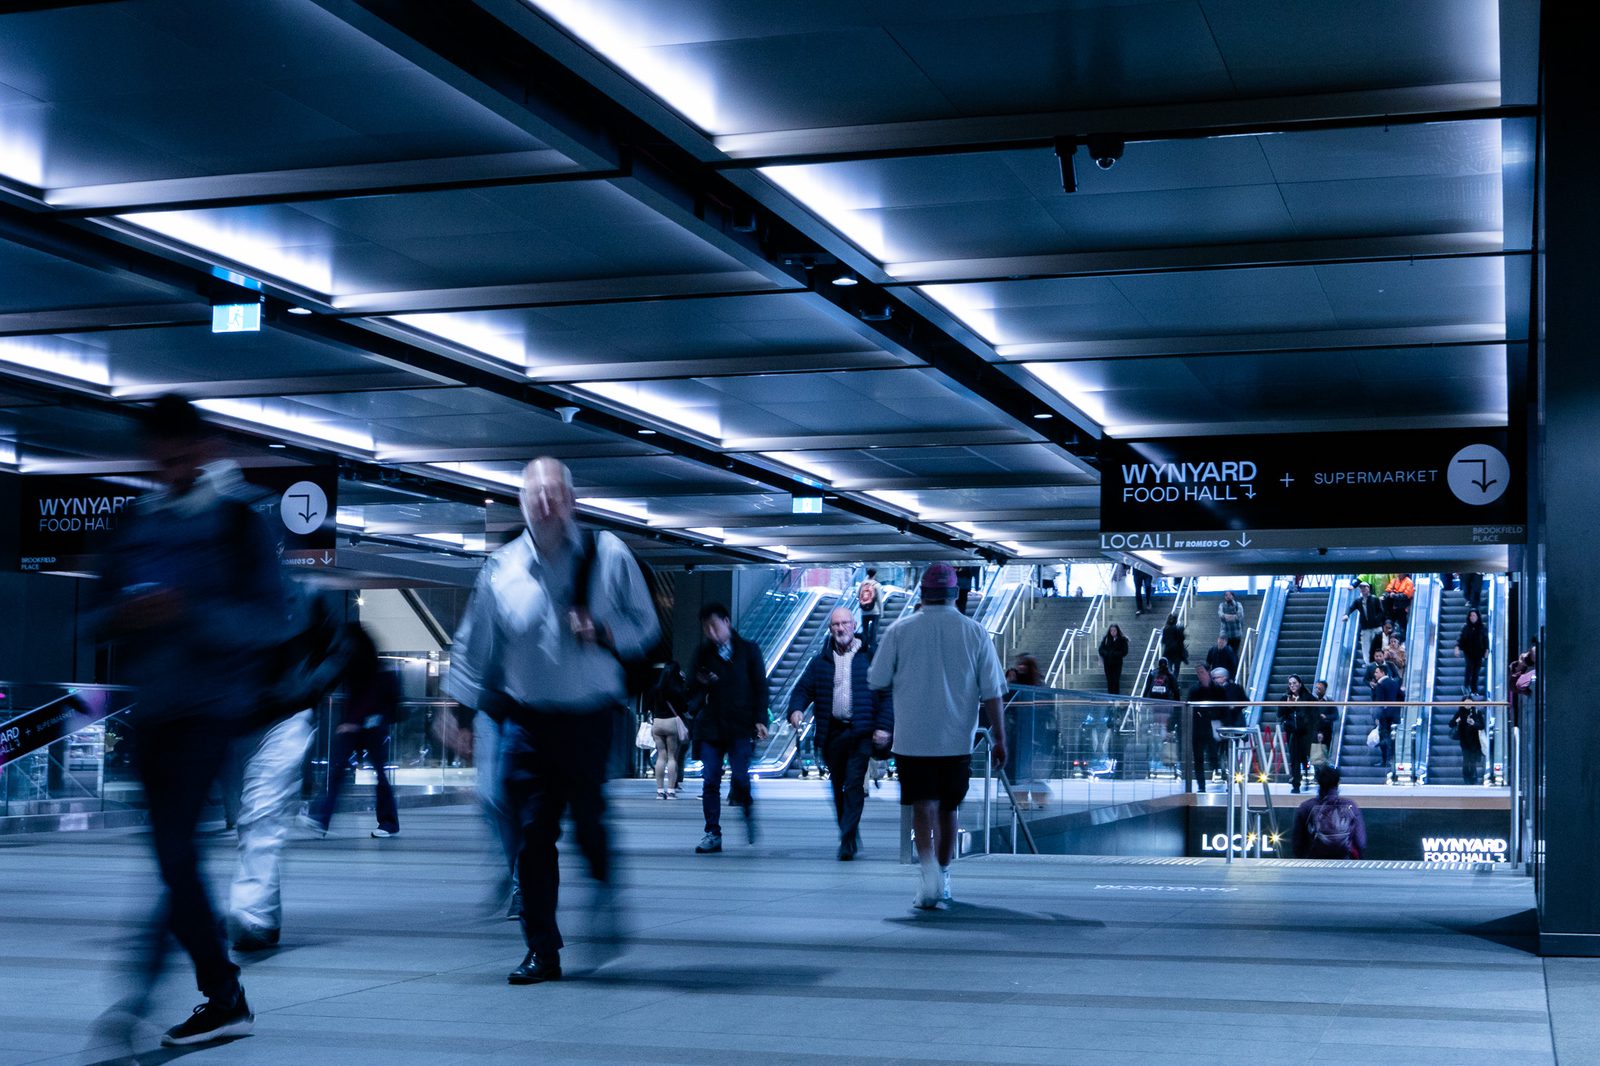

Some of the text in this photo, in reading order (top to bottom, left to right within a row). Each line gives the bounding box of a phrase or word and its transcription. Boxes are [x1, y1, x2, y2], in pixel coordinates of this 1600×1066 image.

[1121, 461, 1257, 484] WYNYARD
[1314, 470, 1438, 485] SUPERMARKET
[1123, 485, 1238, 502] FOOD HALL
[40, 517, 116, 531] FOOD HAL
[1472, 526, 1523, 534] BROOKFIELD
[1101, 533, 1171, 549] LOCALI
[1185, 540, 1218, 548] ROMEO'S
[1202, 833, 1279, 852] LOCAL
[1421, 837, 1508, 853] WYNYARD
[1424, 852, 1495, 863] FOOD HALL
